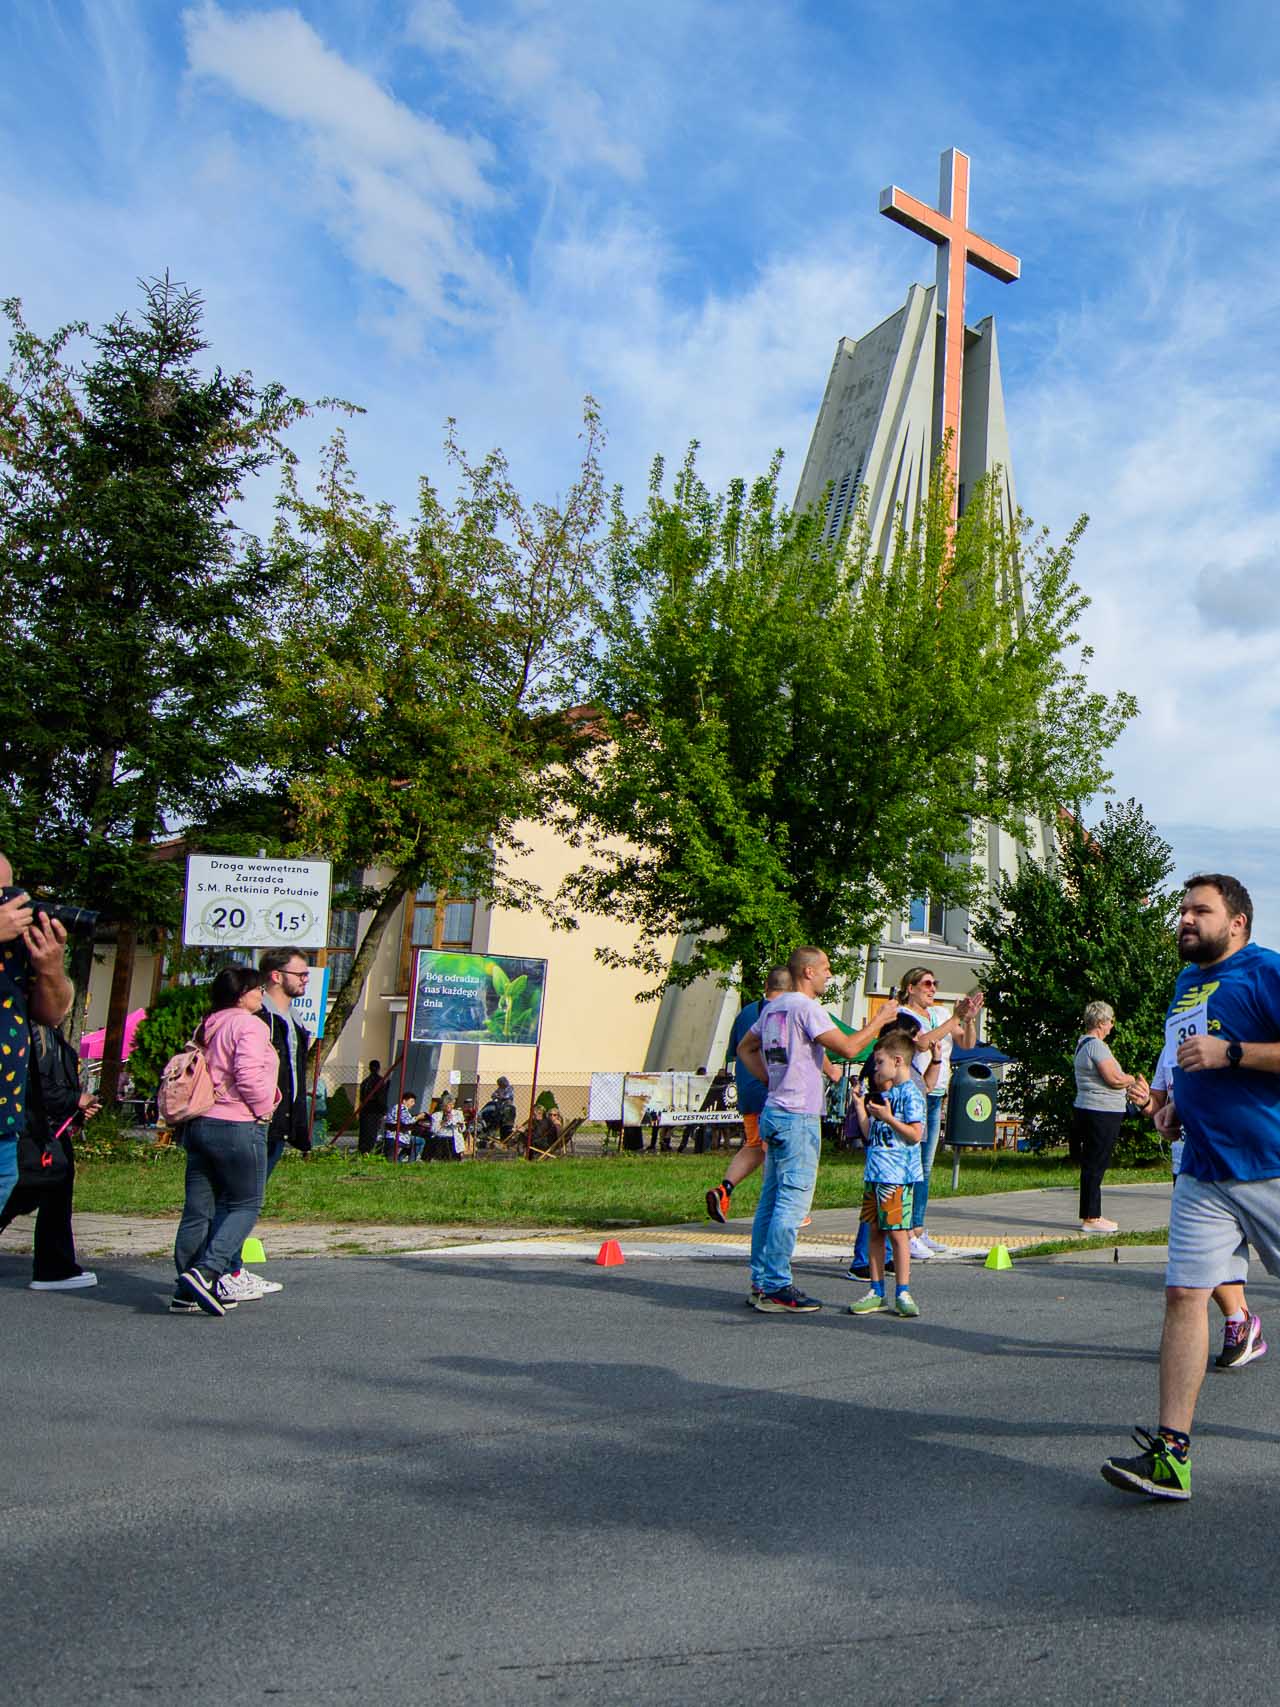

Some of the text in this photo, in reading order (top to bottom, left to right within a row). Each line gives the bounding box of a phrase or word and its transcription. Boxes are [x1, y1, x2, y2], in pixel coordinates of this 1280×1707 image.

[211, 860, 244, 872] Droga
[225, 884, 269, 895] Retkinia
[273, 886, 319, 897] Południe
[212, 907, 245, 929] 20
[425, 972, 480, 984] Bóg odradza
[424, 985, 478, 998] nas każdego
[292, 997, 313, 1009] DIO
[423, 998, 443, 1008] dnia
